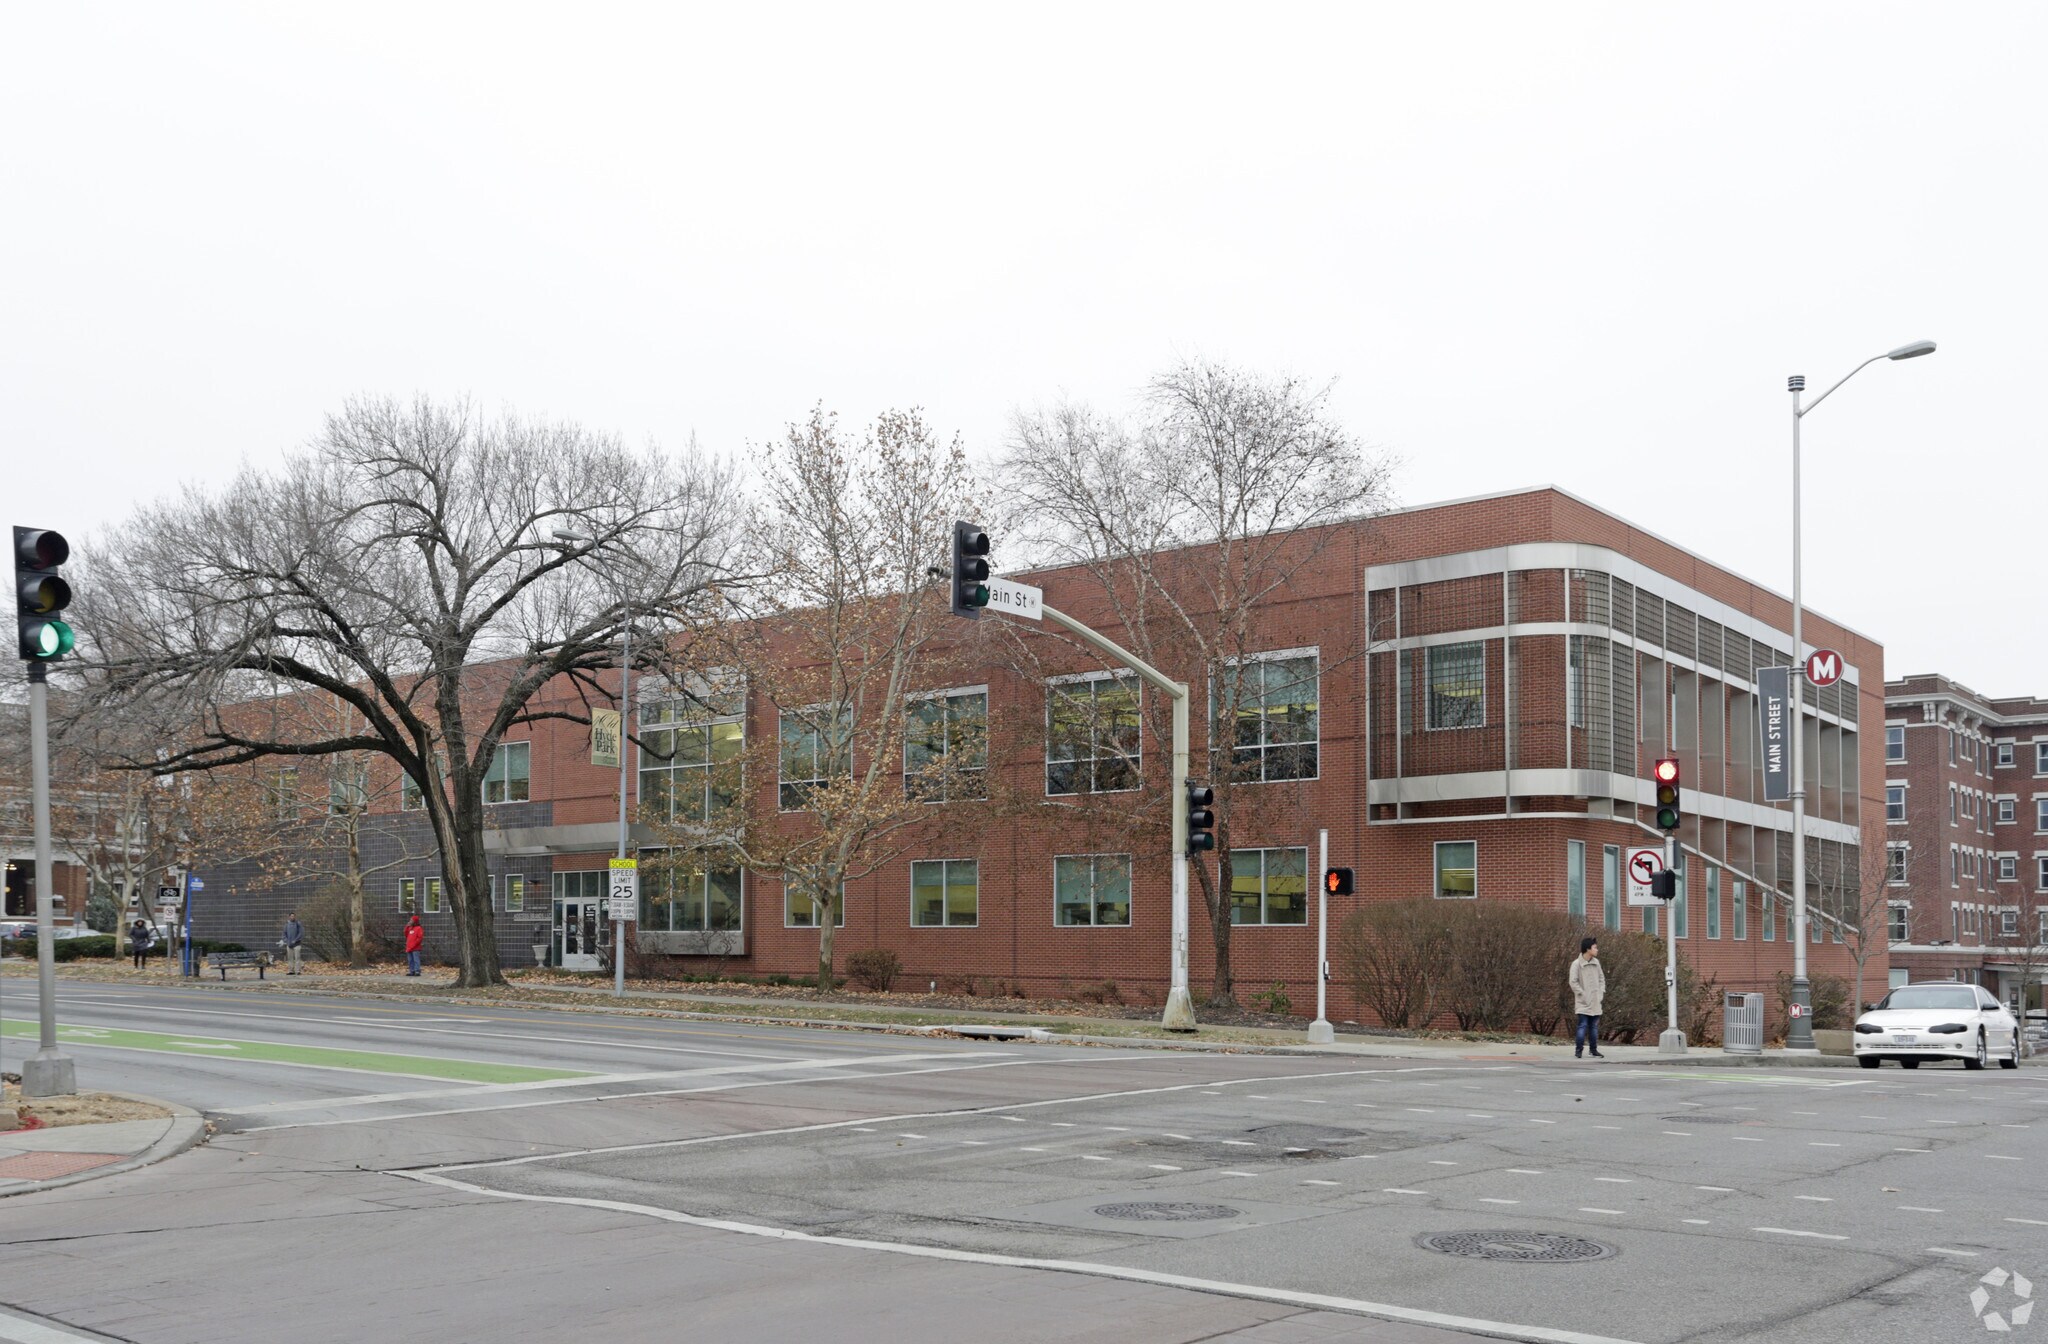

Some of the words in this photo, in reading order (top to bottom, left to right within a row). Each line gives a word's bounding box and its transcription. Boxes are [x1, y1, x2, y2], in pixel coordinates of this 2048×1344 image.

[988, 585, 1010, 604] ain
[1015, 592, 1027, 608] St
[1813, 655, 1835, 680] M
[1768, 696, 1781, 739] STREET
[595, 728, 617, 742] Hyde
[596, 740, 617, 754] Park
[1769, 744, 1781, 773] MAIN
[611, 860, 635, 868] SCHOOL
[612, 869, 634, 877] SPEED
[613, 885, 633, 899] 25
